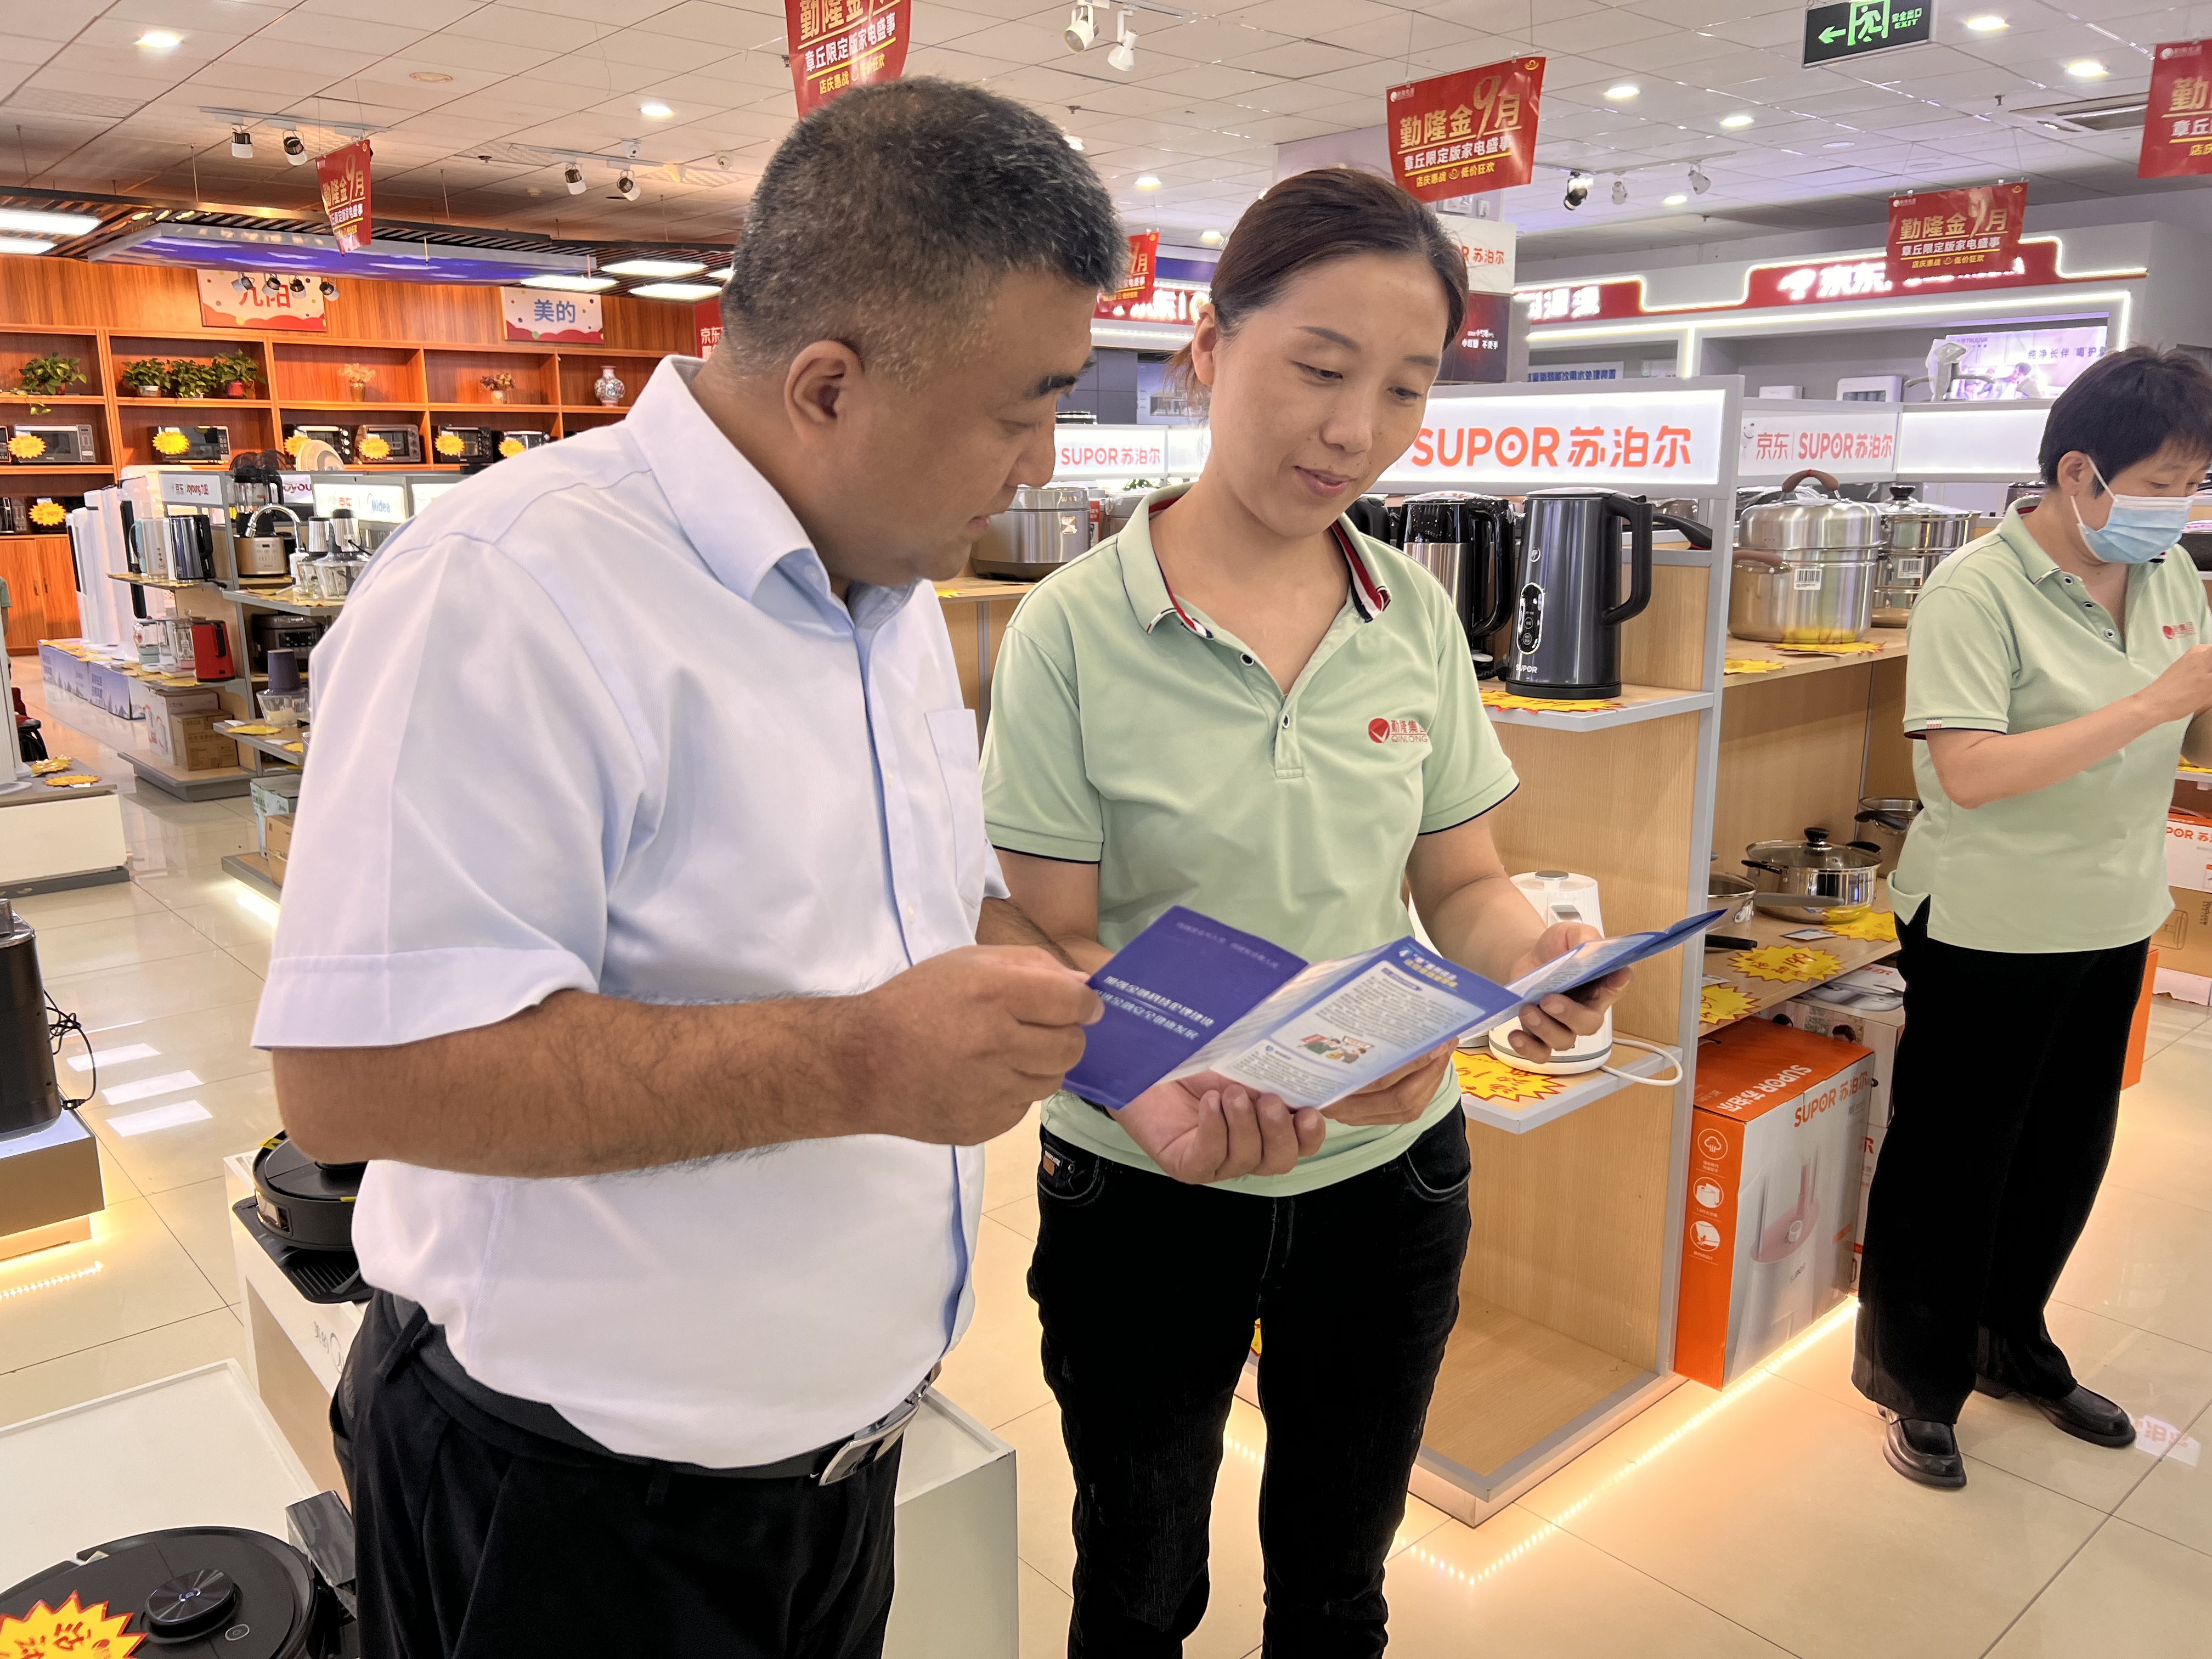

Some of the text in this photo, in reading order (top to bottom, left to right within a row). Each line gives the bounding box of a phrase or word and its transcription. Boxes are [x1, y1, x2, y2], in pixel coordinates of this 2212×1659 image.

[799, 0, 891, 42] 勤隆金
[1894, 19, 1918, 29] EXIT
[805, 12, 895, 72] 章丘限定版家电盛事
[2169, 76, 2212, 111] 勤
[1400, 75, 1521, 149] 勤隆金9月
[2171, 118, 2212, 137] 章丘
[1404, 135, 1512, 172] 章丘限定版家电盛事
[1462, 162, 1494, 178] 低价狂欢
[1899, 187, 2008, 240] 勤隆金9月
[1474, 248, 1504, 264] 苏泊尔
[1901, 236, 2001, 256] 章丘限定版家电盛事
[533, 298, 575, 324] 美的
[701, 326, 724, 345] 京东
[1061, 447, 1160, 465] SUPOR 苏泊尔
[1412, 425, 1691, 468] SUPOR 苏泊尔
[1756, 432, 1893, 460] 京东 SUPOR 苏泊尔
[283, 483, 312, 493] oyou
[371, 499, 390, 514] Midea
[1515, 663, 1538, 674] SUPOR
[1391, 720, 1426, 733] 勤隆集
[2166, 827, 2212, 842] POR 苏
[1753, 1064, 1812, 1092] SUPOR
[1717, 1090, 1765, 1112] 苏泊尔
[1794, 1088, 1837, 1127] SUPOR
[1839, 1071, 1869, 1102] 苏泊尔
